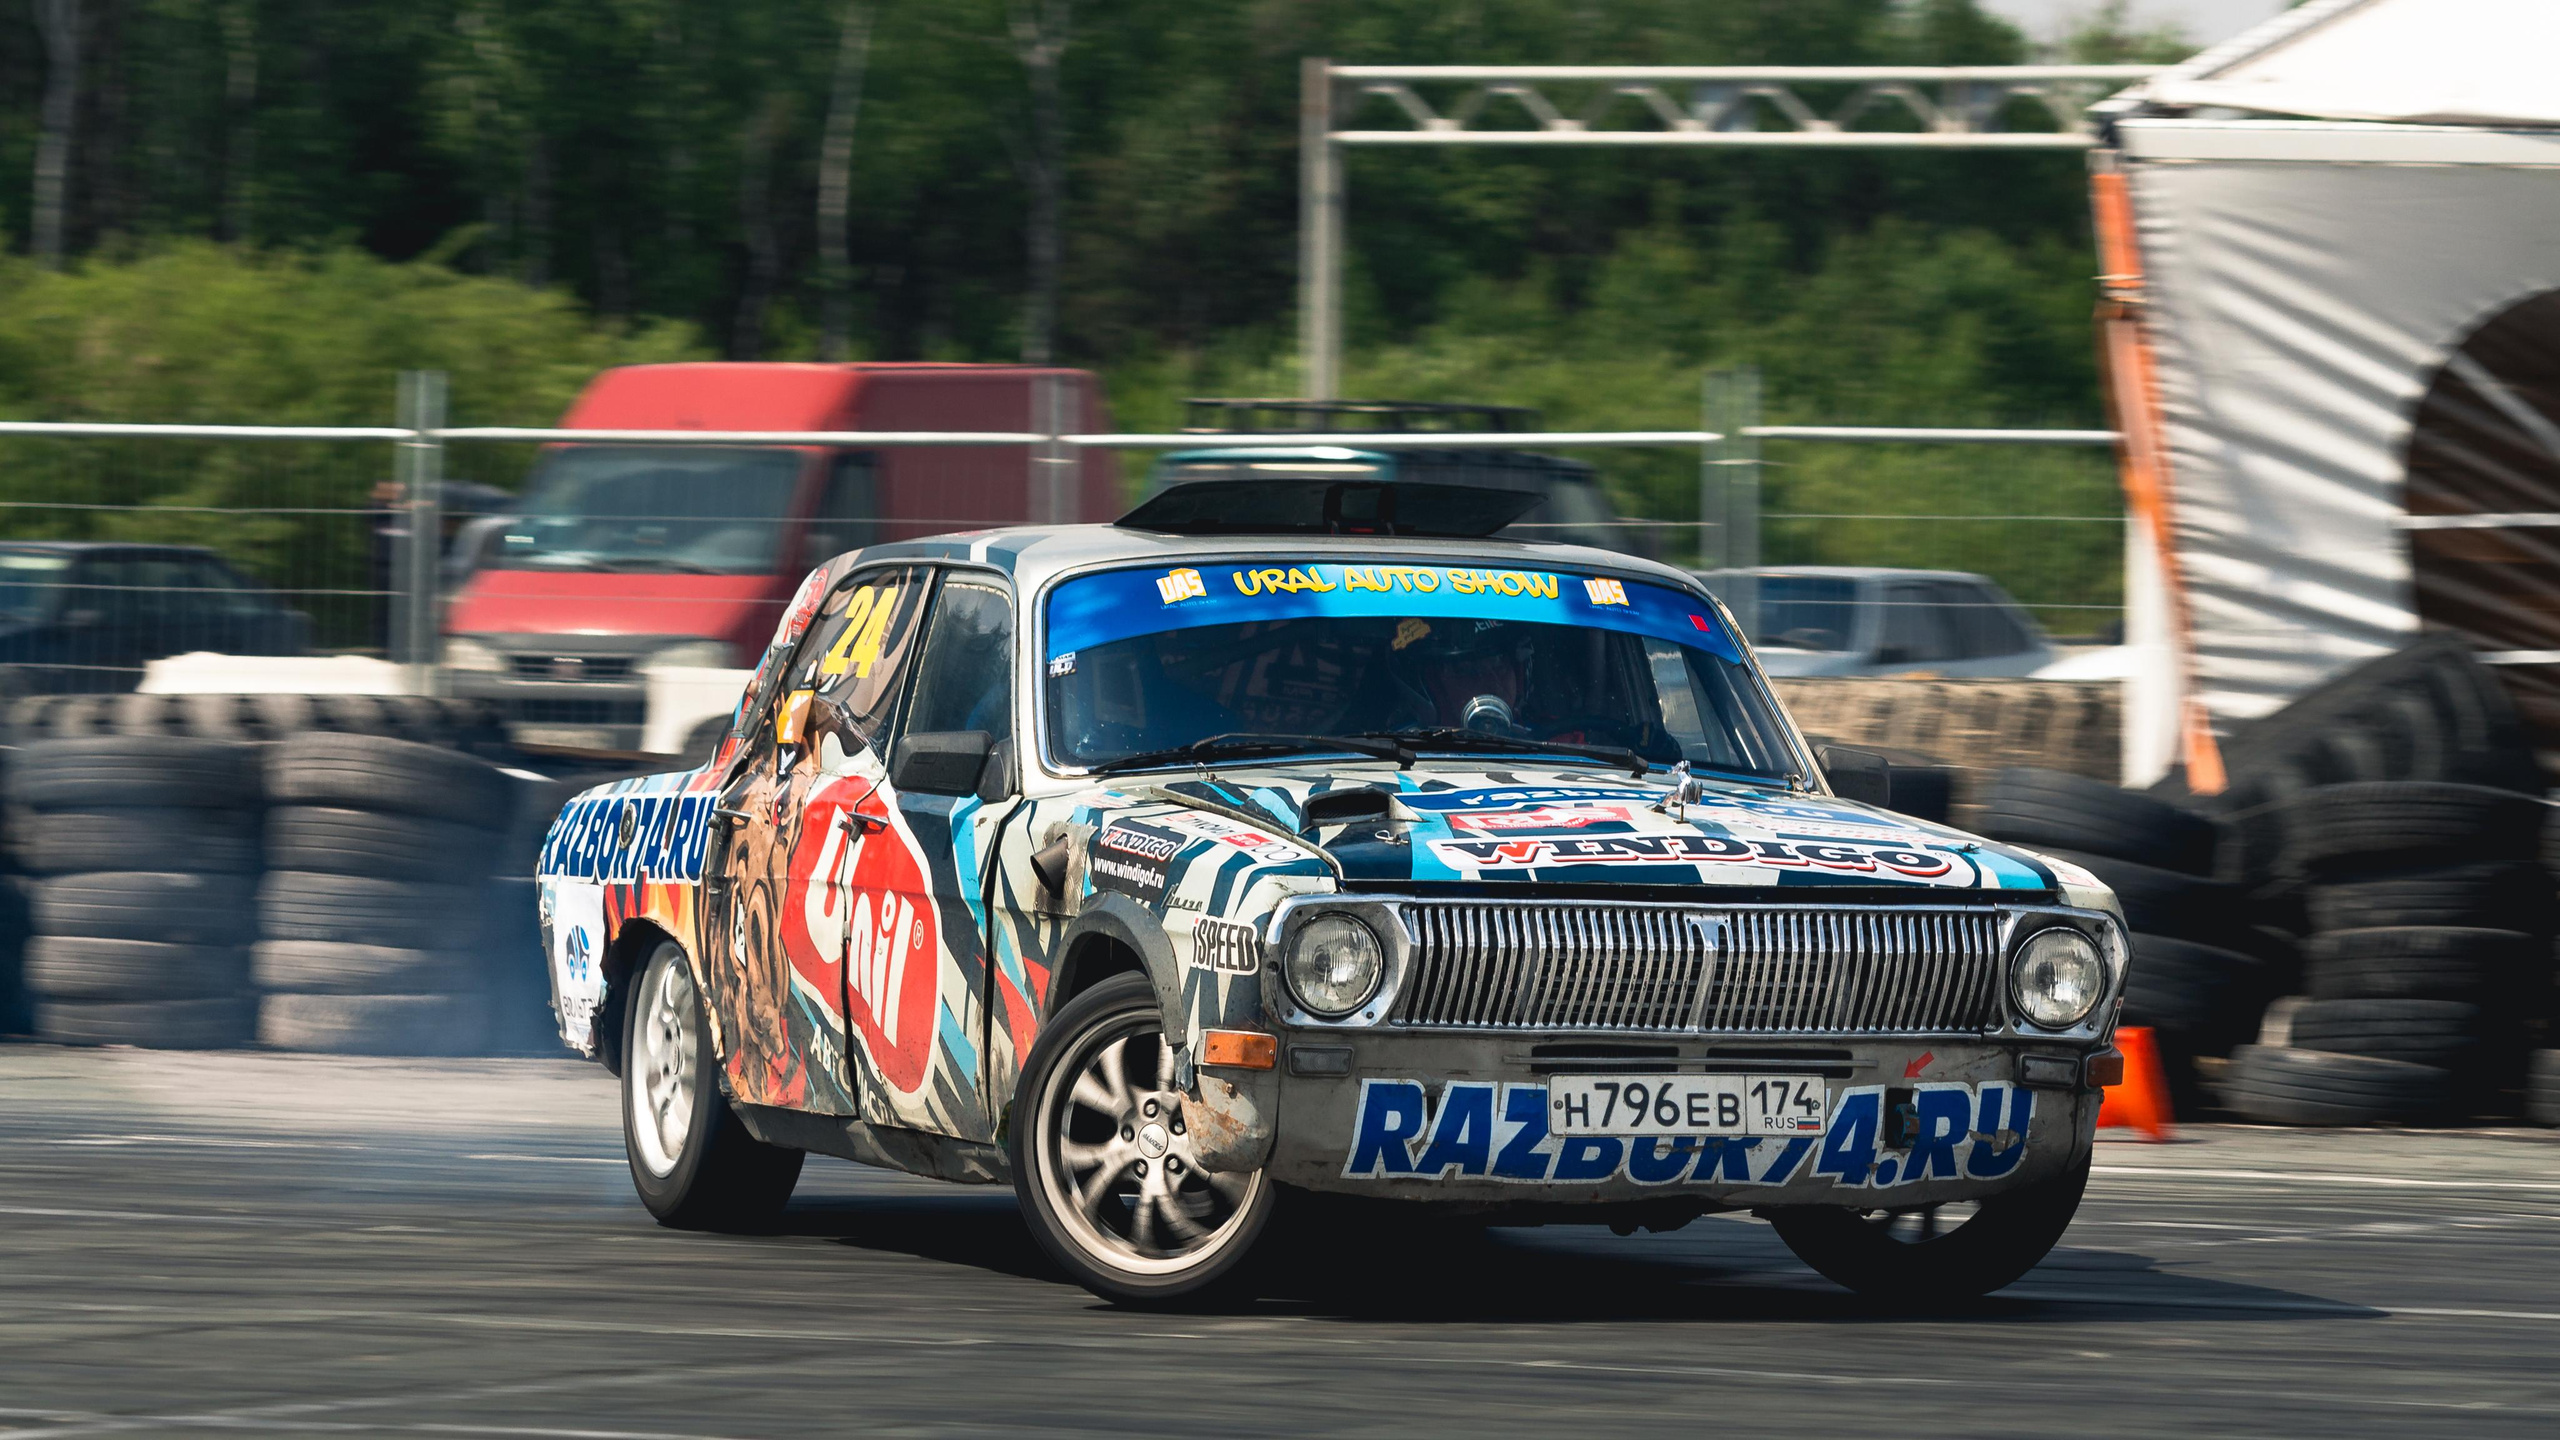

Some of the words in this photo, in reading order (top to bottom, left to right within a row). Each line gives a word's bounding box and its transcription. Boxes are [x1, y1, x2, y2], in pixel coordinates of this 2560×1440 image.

[1156, 569, 1207, 604] UAS
[1232, 568, 1337, 596] URAL
[1344, 567, 1439, 593] AUTO
[1447, 570, 1559, 599] SHOW
[1583, 578, 1629, 606] UAS
[822, 585, 899, 679] 24
[1101, 826, 1176, 862] WINDIGO
[1441, 836, 1952, 877] WINDIGO
[1094, 857, 1165, 889] www.windigof.ru
[1192, 917, 1256, 971] iSPEED
[1750, 1080, 1813, 1116] 174
[1764, 1116, 1795, 1129] RUS
